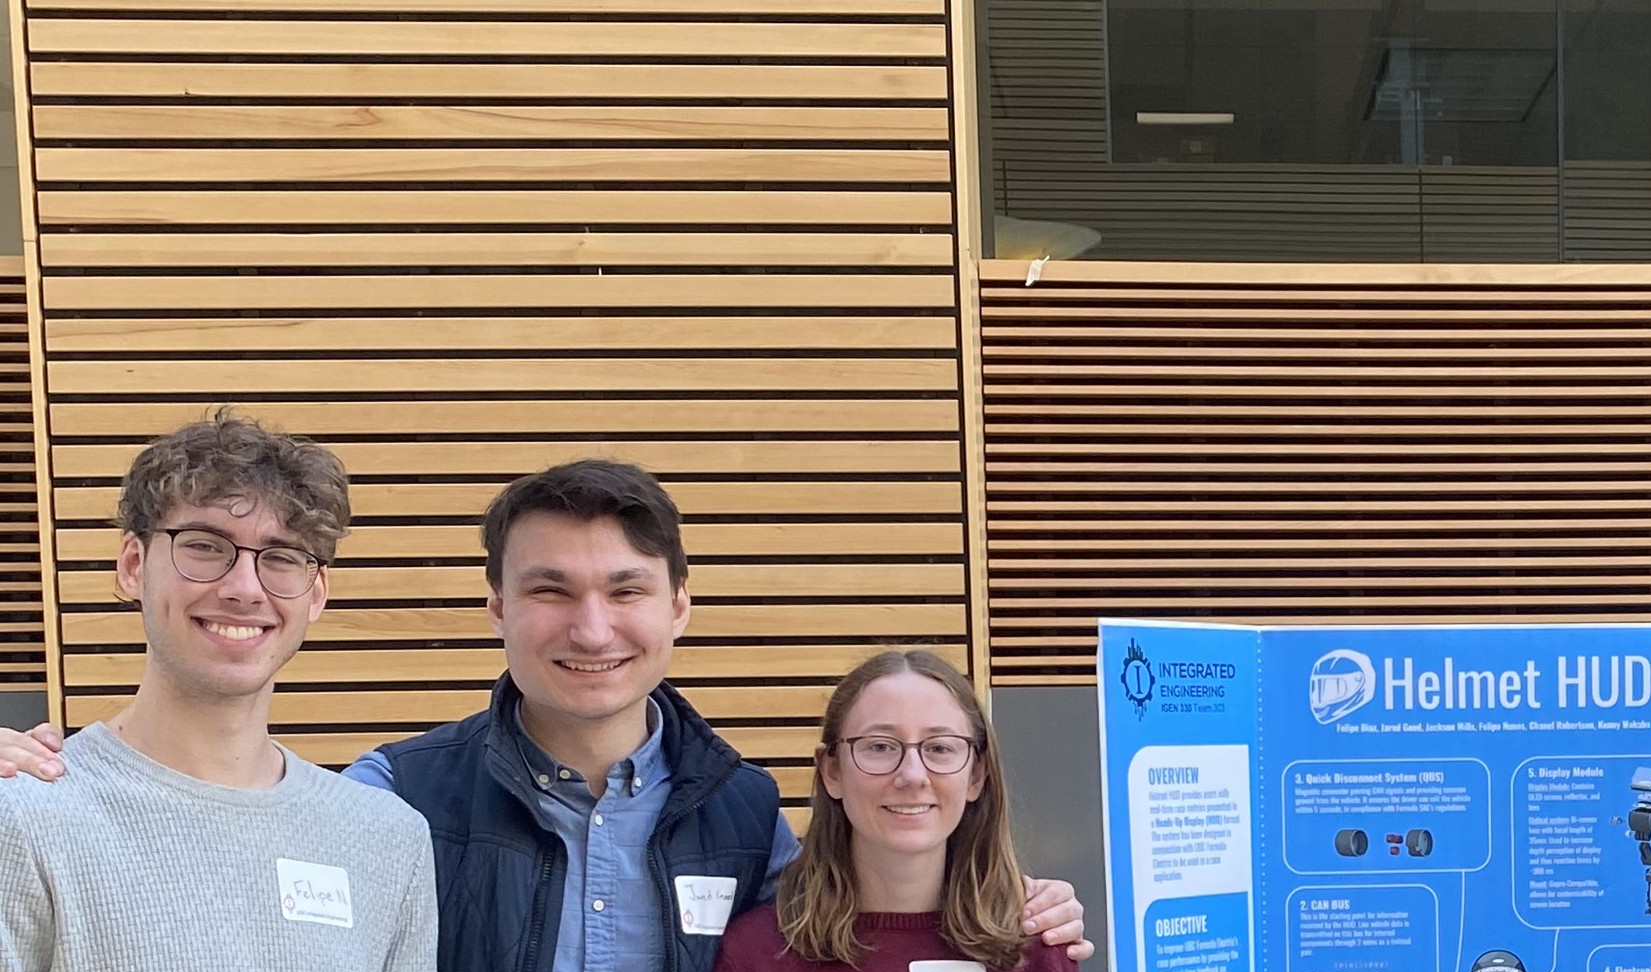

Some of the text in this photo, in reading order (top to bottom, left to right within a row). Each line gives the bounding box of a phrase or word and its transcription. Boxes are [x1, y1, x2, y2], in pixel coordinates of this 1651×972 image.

[1159, 662, 1236, 679] INTEGRATED
[1384, 655, 1651, 710] Helmet HUD
[1160, 685, 1225, 698] ENGINEERING
[1148, 767, 1199, 785] OVERVIEW
[1295, 771, 1444, 785] 3. Quick Disconnect System (QDS)
[1528, 767, 1604, 779] 5. Display Module
[1300, 900, 1350, 910] 2. CAN BUS
[1156, 915, 1208, 938] OBJECTIVE
